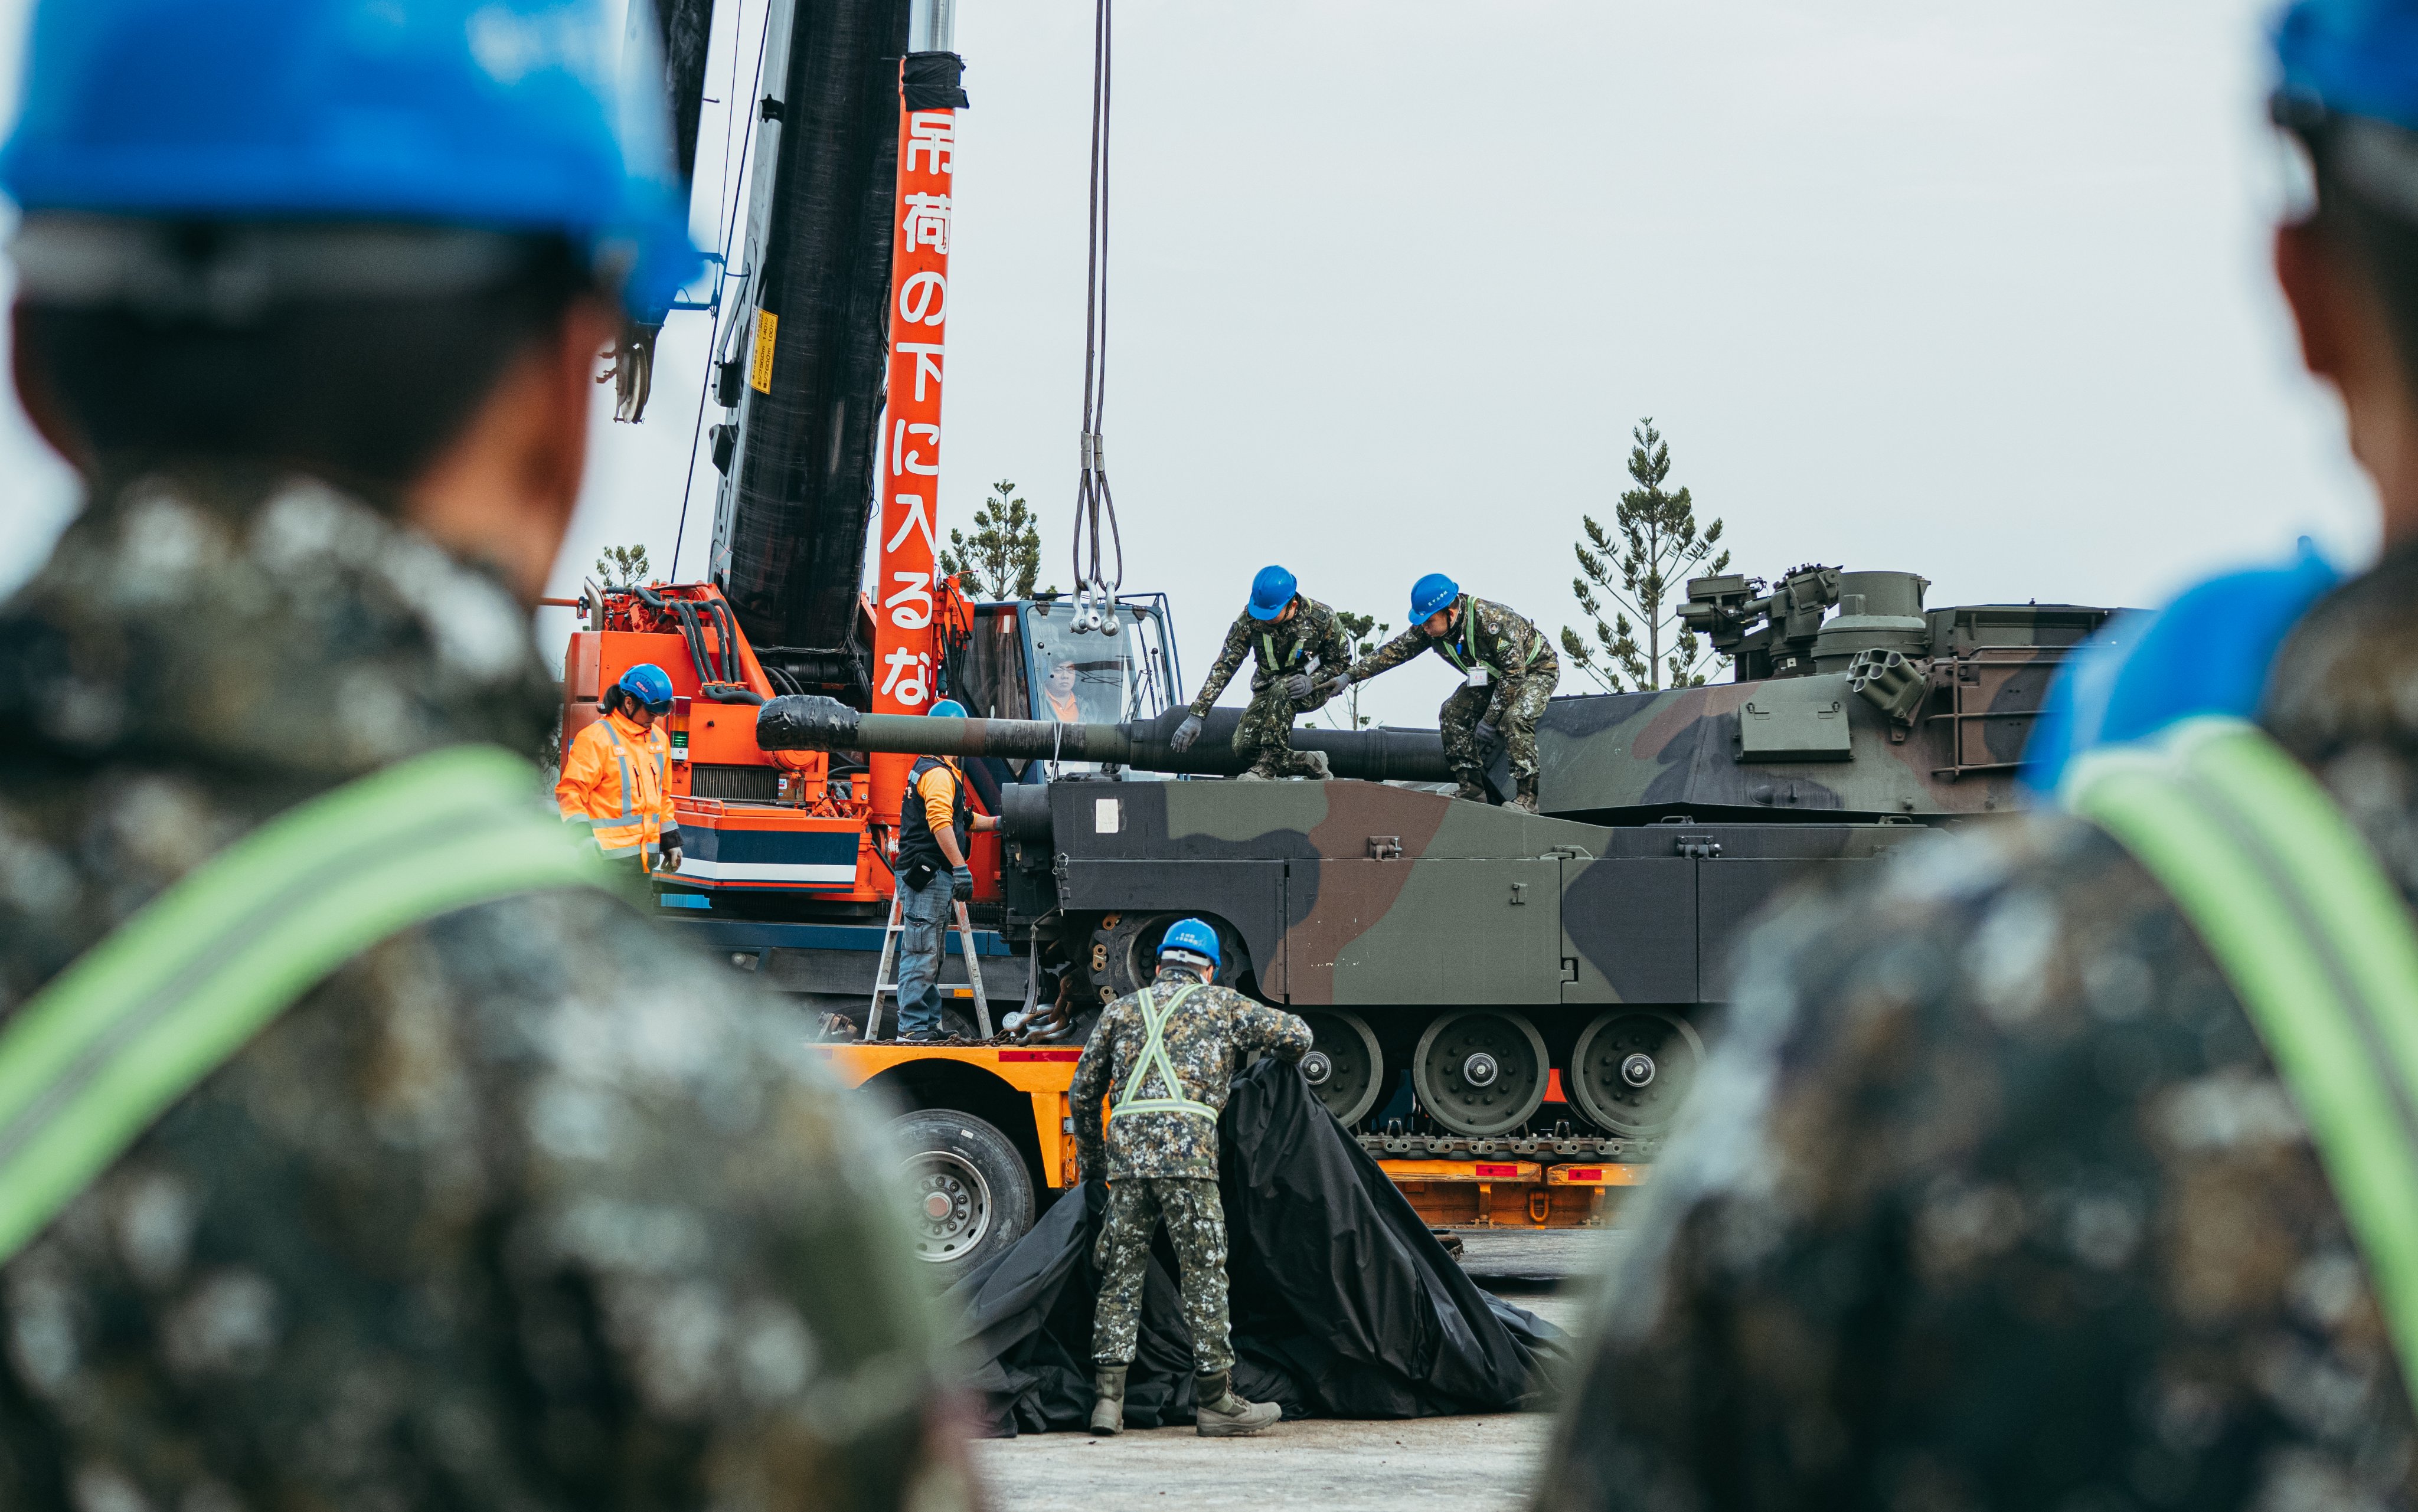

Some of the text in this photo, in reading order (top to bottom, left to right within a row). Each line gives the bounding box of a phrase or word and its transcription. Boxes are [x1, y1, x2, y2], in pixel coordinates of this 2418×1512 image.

[881, 112, 955, 706] 吊荷の下に入るな
